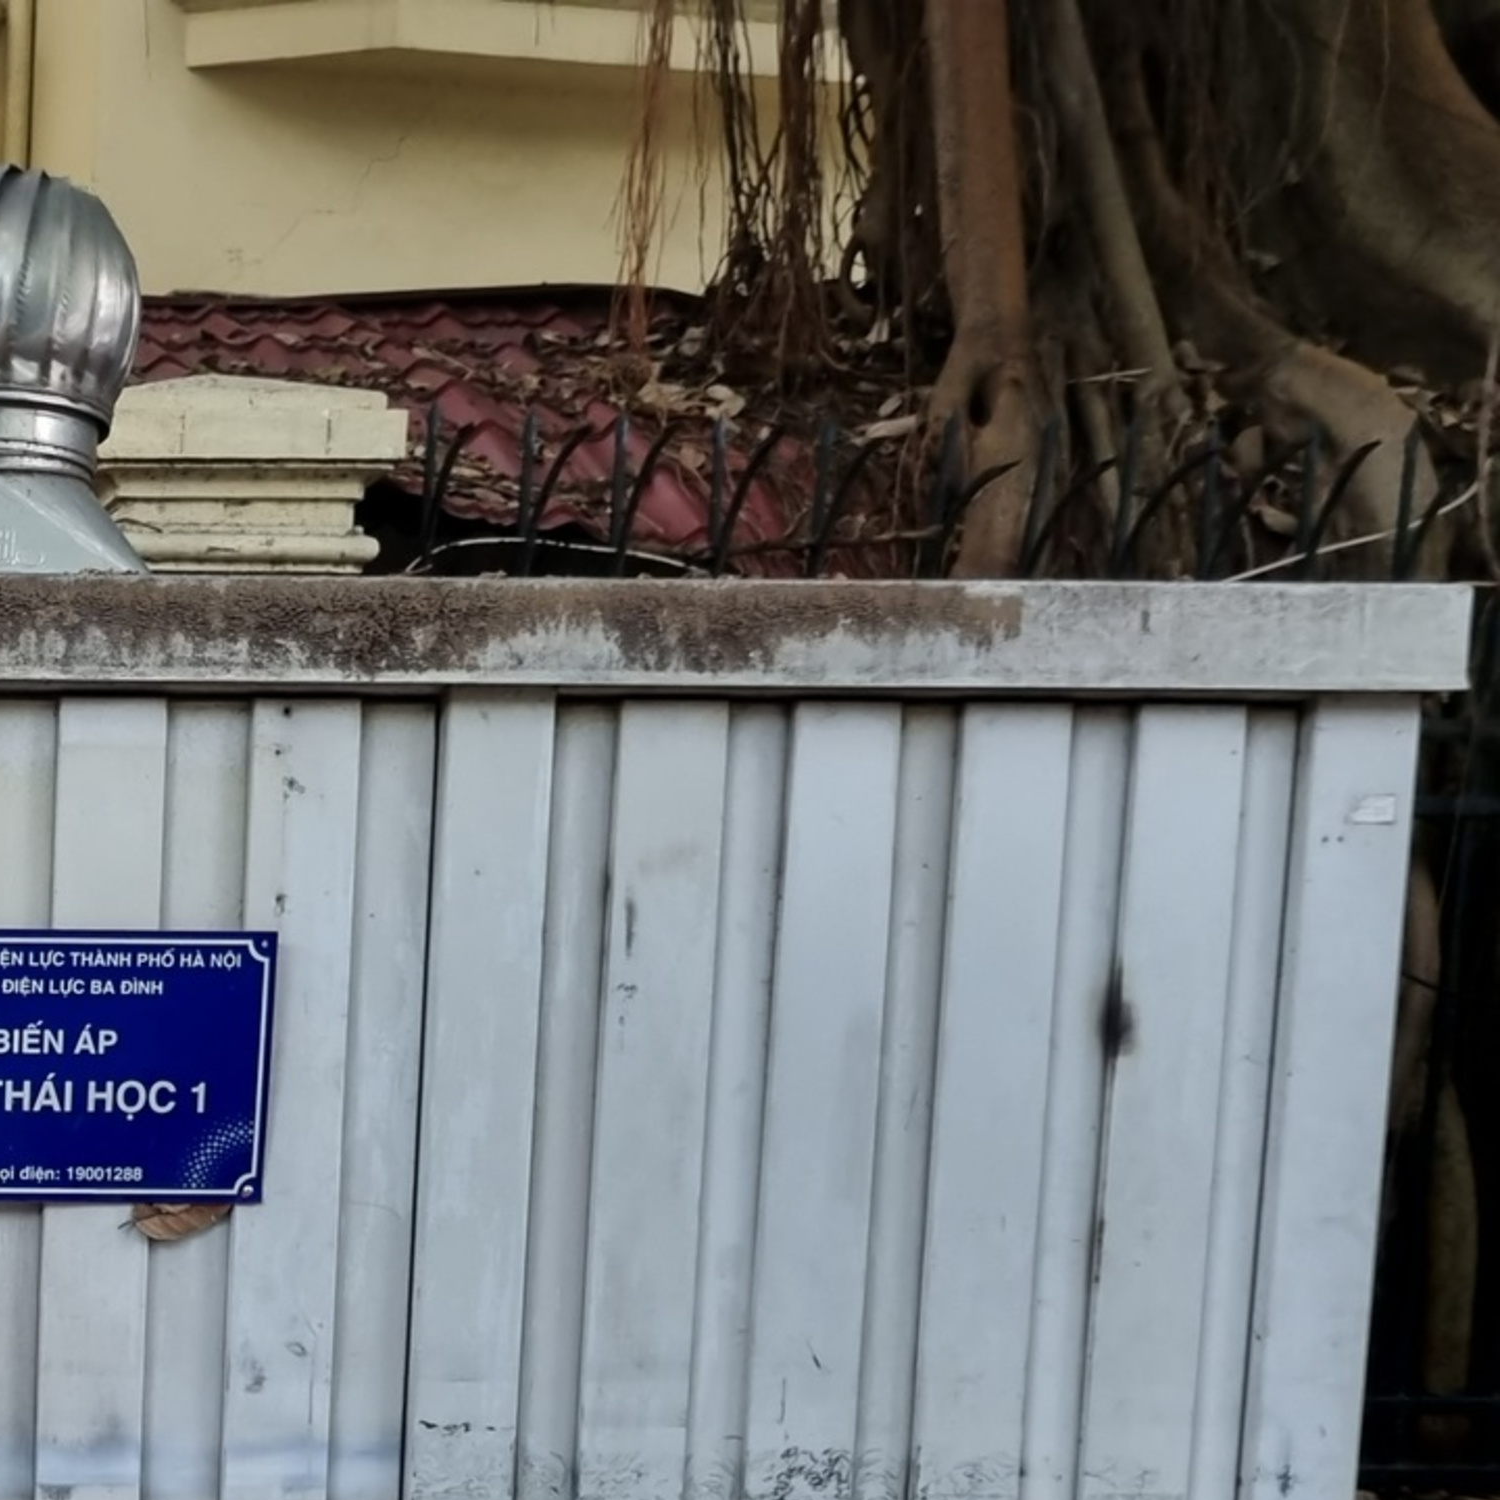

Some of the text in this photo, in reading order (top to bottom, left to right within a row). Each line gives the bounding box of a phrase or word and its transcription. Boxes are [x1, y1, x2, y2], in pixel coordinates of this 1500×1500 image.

[29, 950, 65, 971] LỰC
[70, 946, 132, 967] THÀNH
[137, 944, 176, 968] PHỐ
[180, 946, 205, 967] HÀ
[210, 946, 242, 972] NỘI
[2, 974, 44, 998] ĐIỆN
[49, 977, 85, 999] LỰC
[90, 979, 115, 995] BA
[120, 975, 163, 995] ĐÌNH
[74, 1022, 118, 1055] ÁP
[87, 1080, 176, 1120] HỌC
[190, 1082, 206, 1113] 1
[19, 1164, 61, 1183] điện:
[66, 1166, 143, 1181] 19001288
